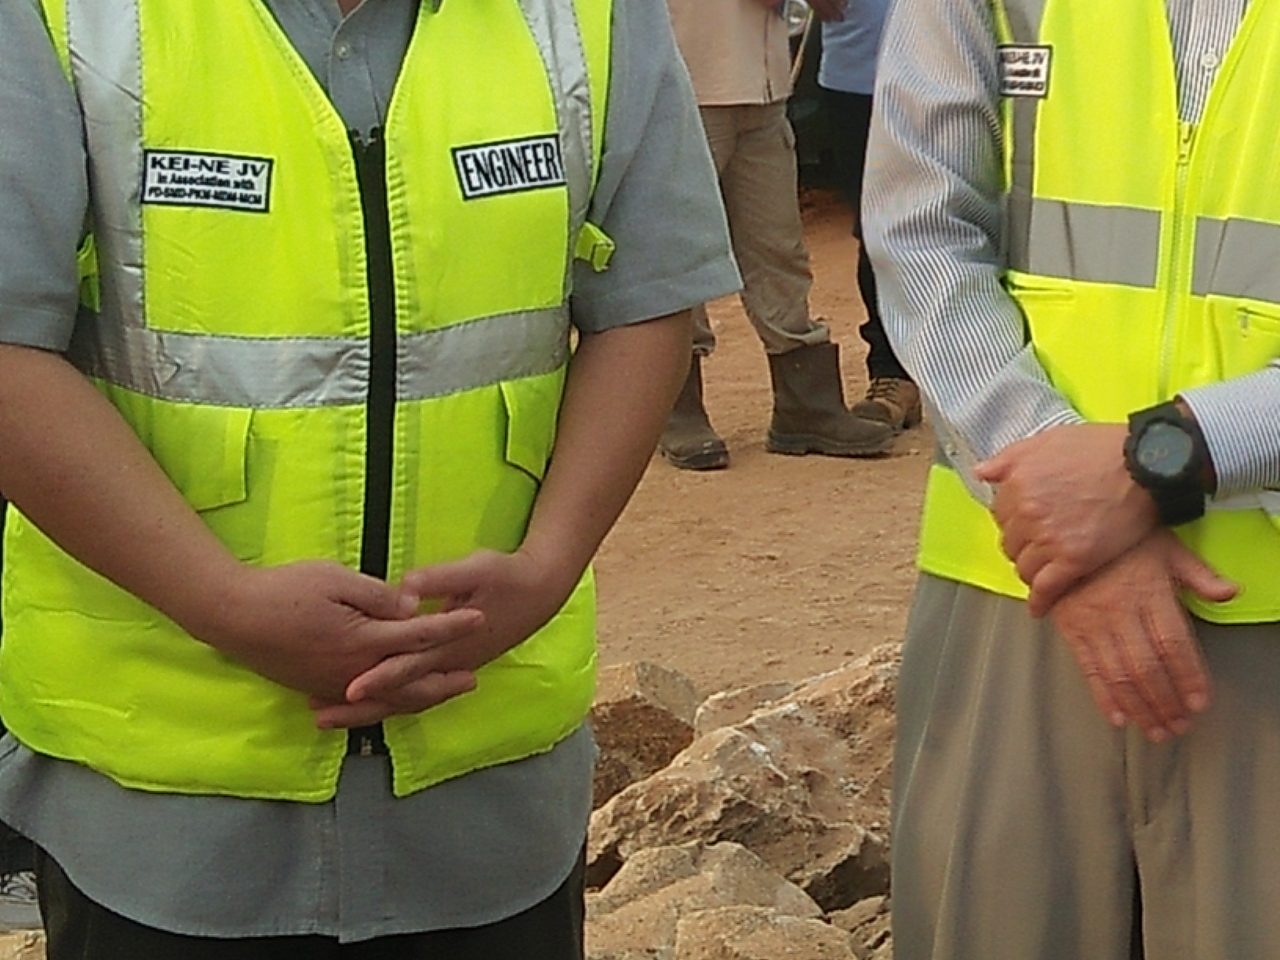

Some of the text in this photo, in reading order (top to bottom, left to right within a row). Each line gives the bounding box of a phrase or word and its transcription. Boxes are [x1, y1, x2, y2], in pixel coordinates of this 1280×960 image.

[150, 156, 266, 178] KEI-NE JV
[460, 142, 560, 192] ENGINEER
